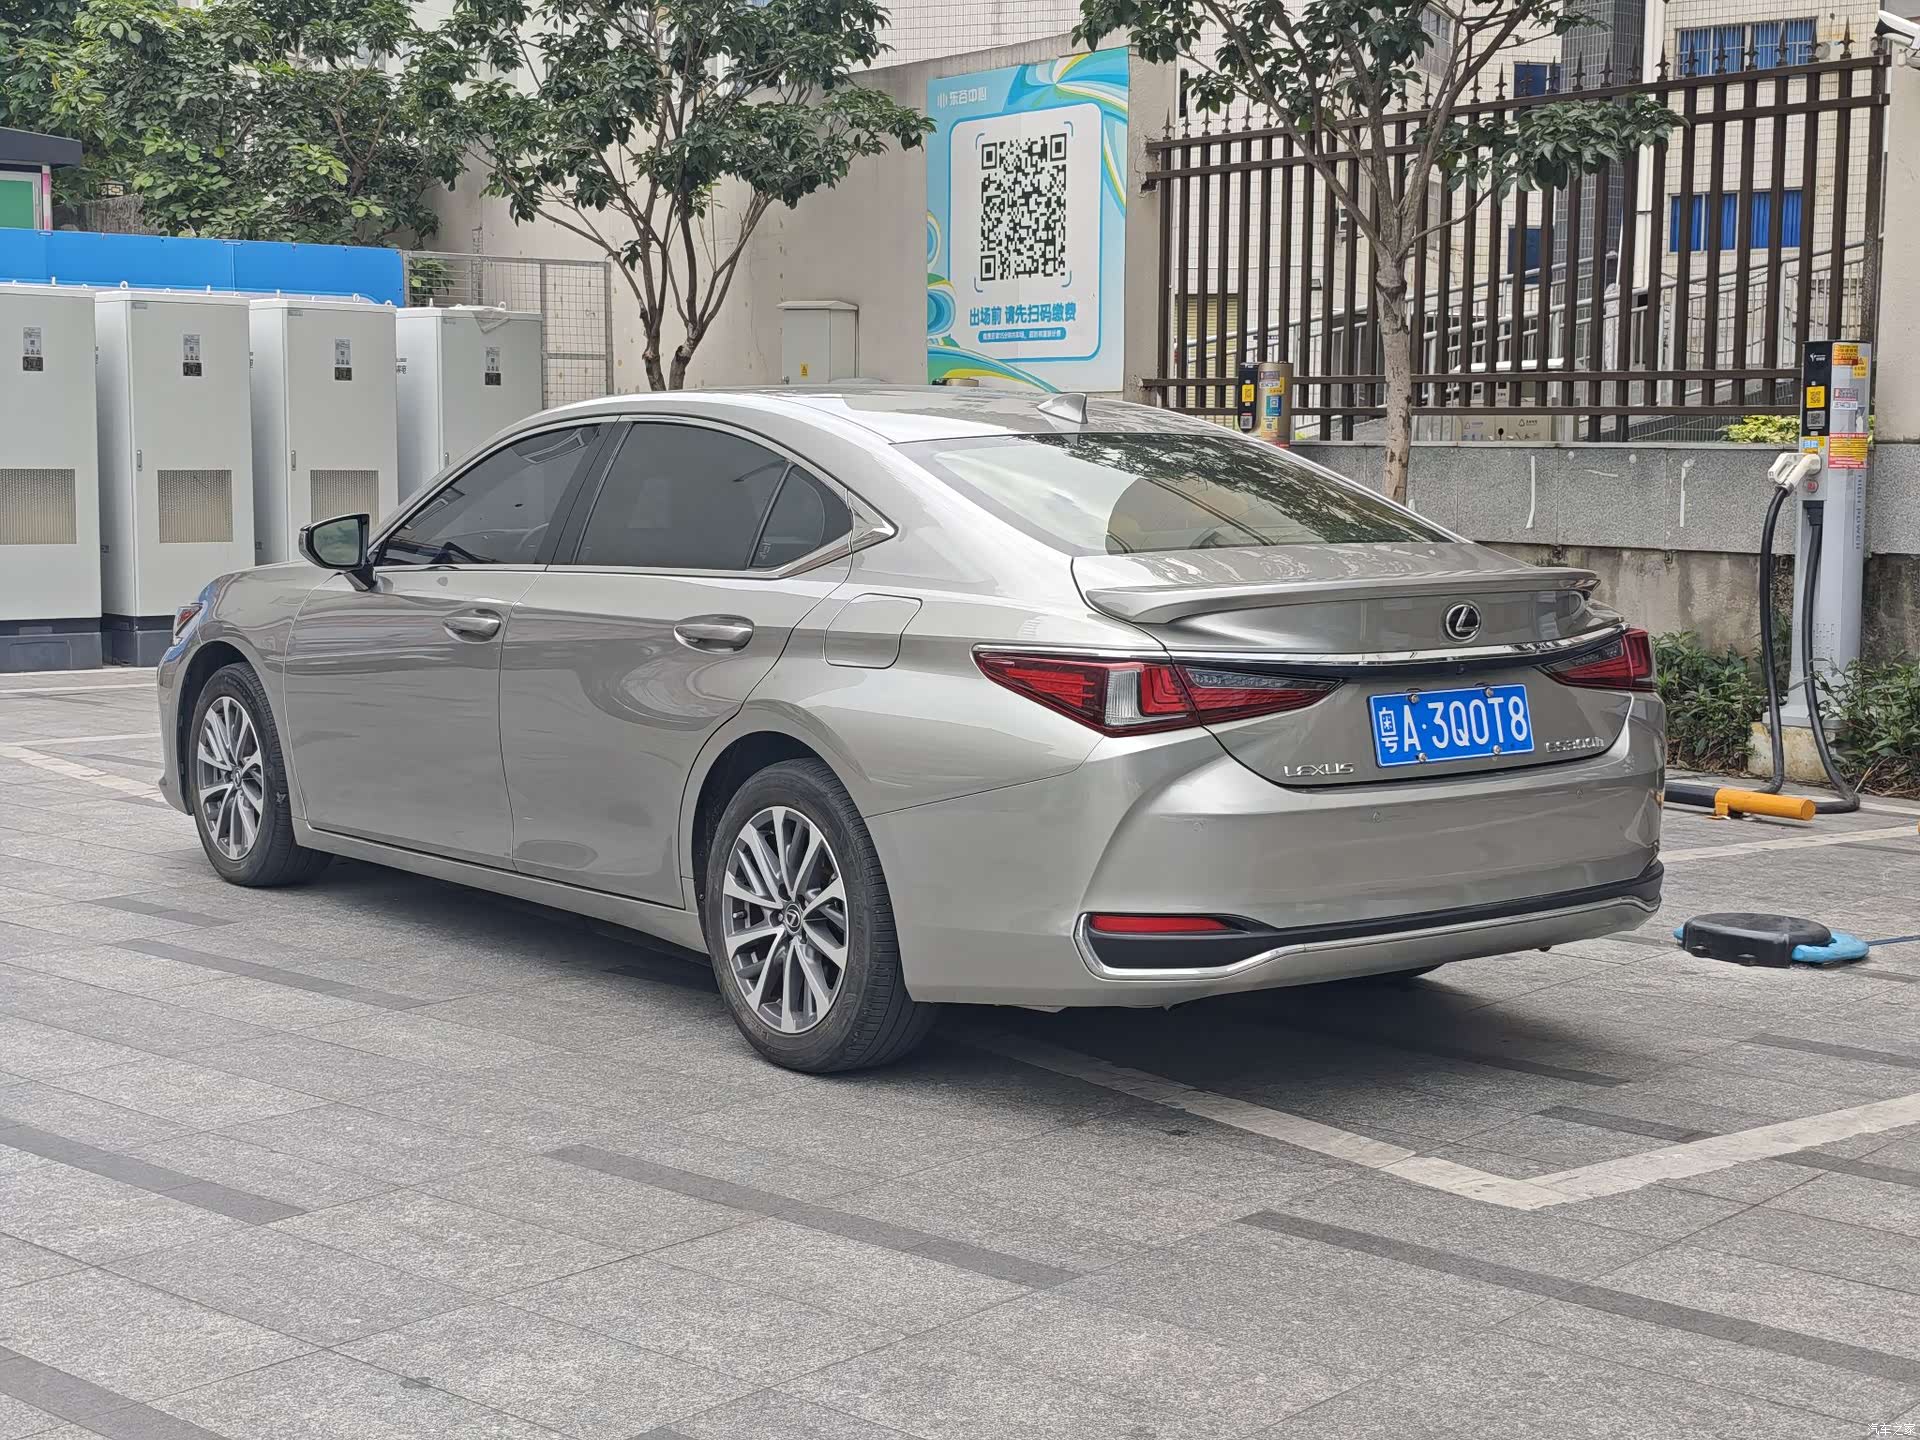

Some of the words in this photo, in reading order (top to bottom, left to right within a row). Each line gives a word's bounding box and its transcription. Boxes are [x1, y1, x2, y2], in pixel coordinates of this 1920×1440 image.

[969, 305, 1002, 326] 出场前
[1005, 302, 1077, 324] 请先扫码缴费
[1283, 762, 1355, 777] LEXUS
